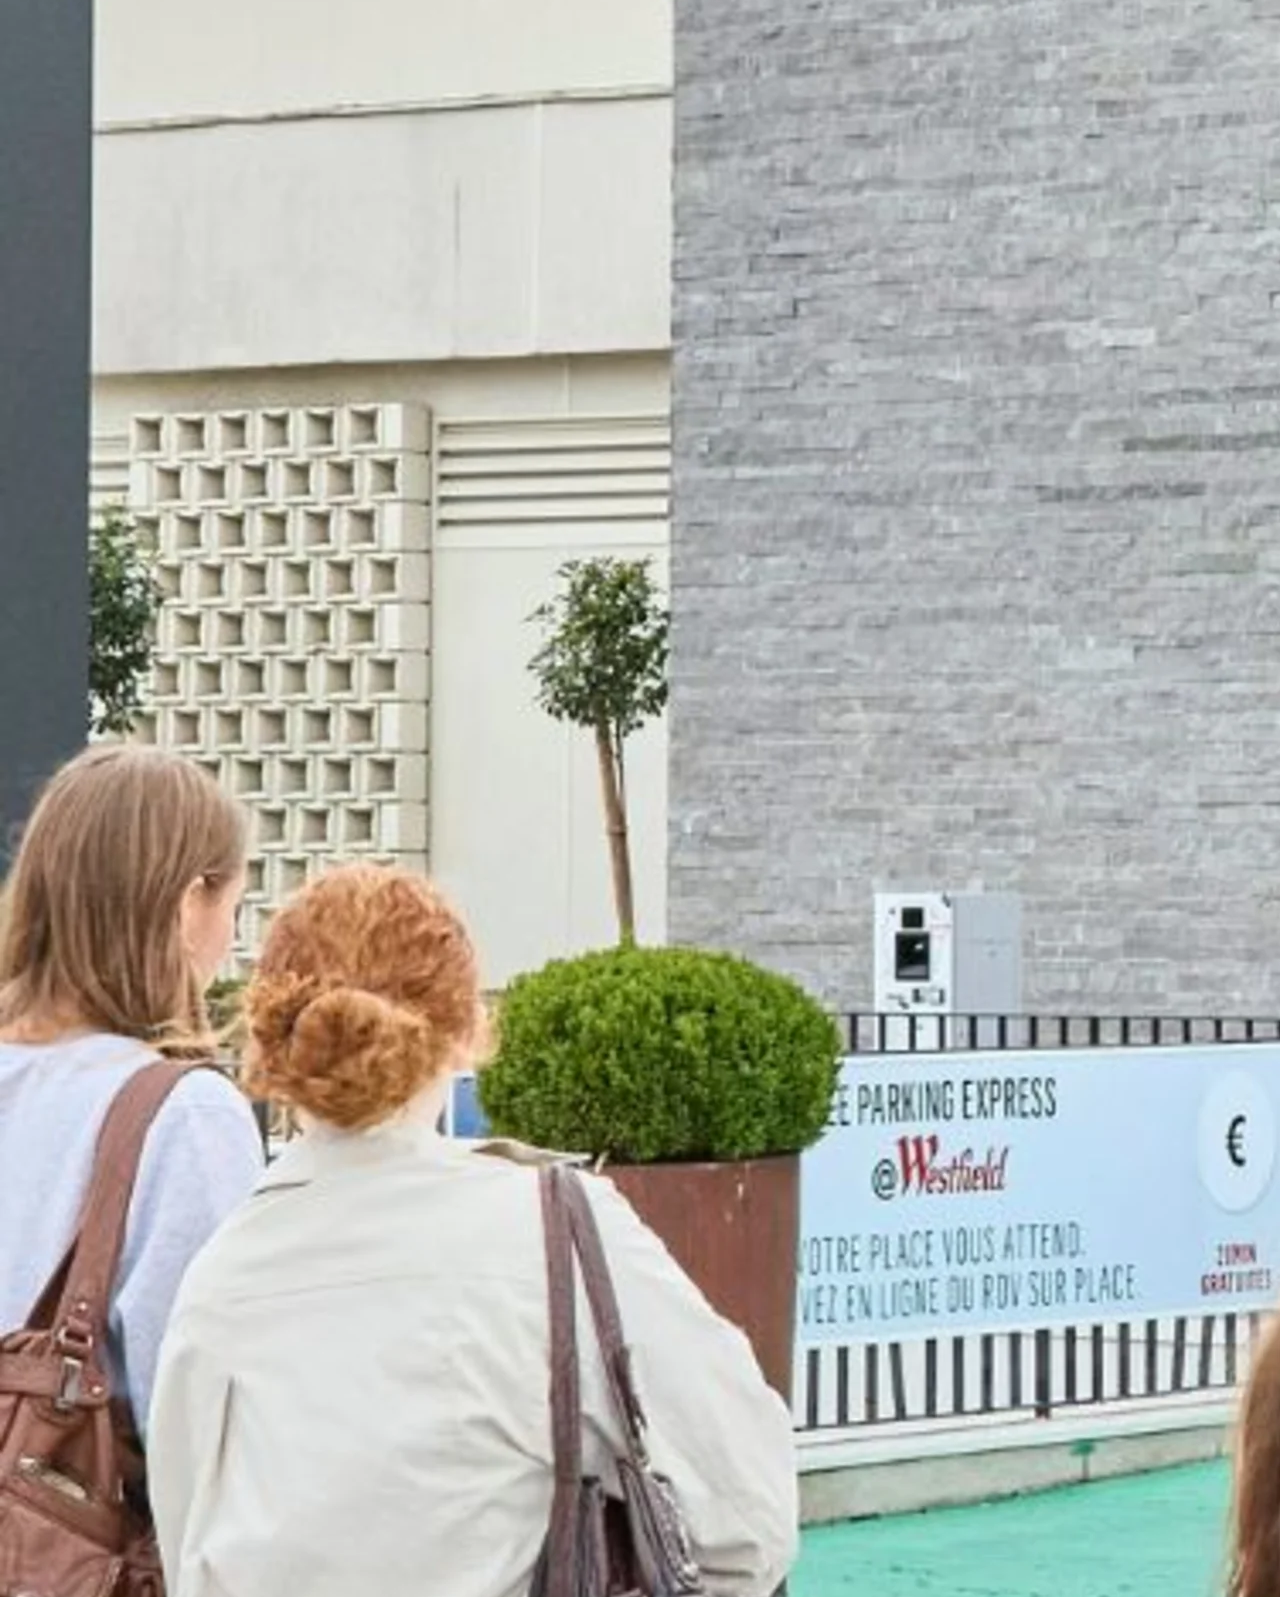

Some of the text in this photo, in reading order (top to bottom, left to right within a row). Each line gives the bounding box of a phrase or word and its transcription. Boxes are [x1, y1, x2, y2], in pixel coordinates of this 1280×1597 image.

[827, 1076, 1058, 1127] E PARKING EXPRESS
[871, 1133, 1010, 1201] @Westfield
[870, 1229, 934, 1271] PLACE
[942, 1224, 995, 1266] VOUS
[846, 1283, 873, 1323] EN
[880, 1277, 940, 1321] LIGNE
[949, 1273, 975, 1314] OU
[982, 1271, 1022, 1311] RDV
[1027, 1267, 1067, 1307] SUR
